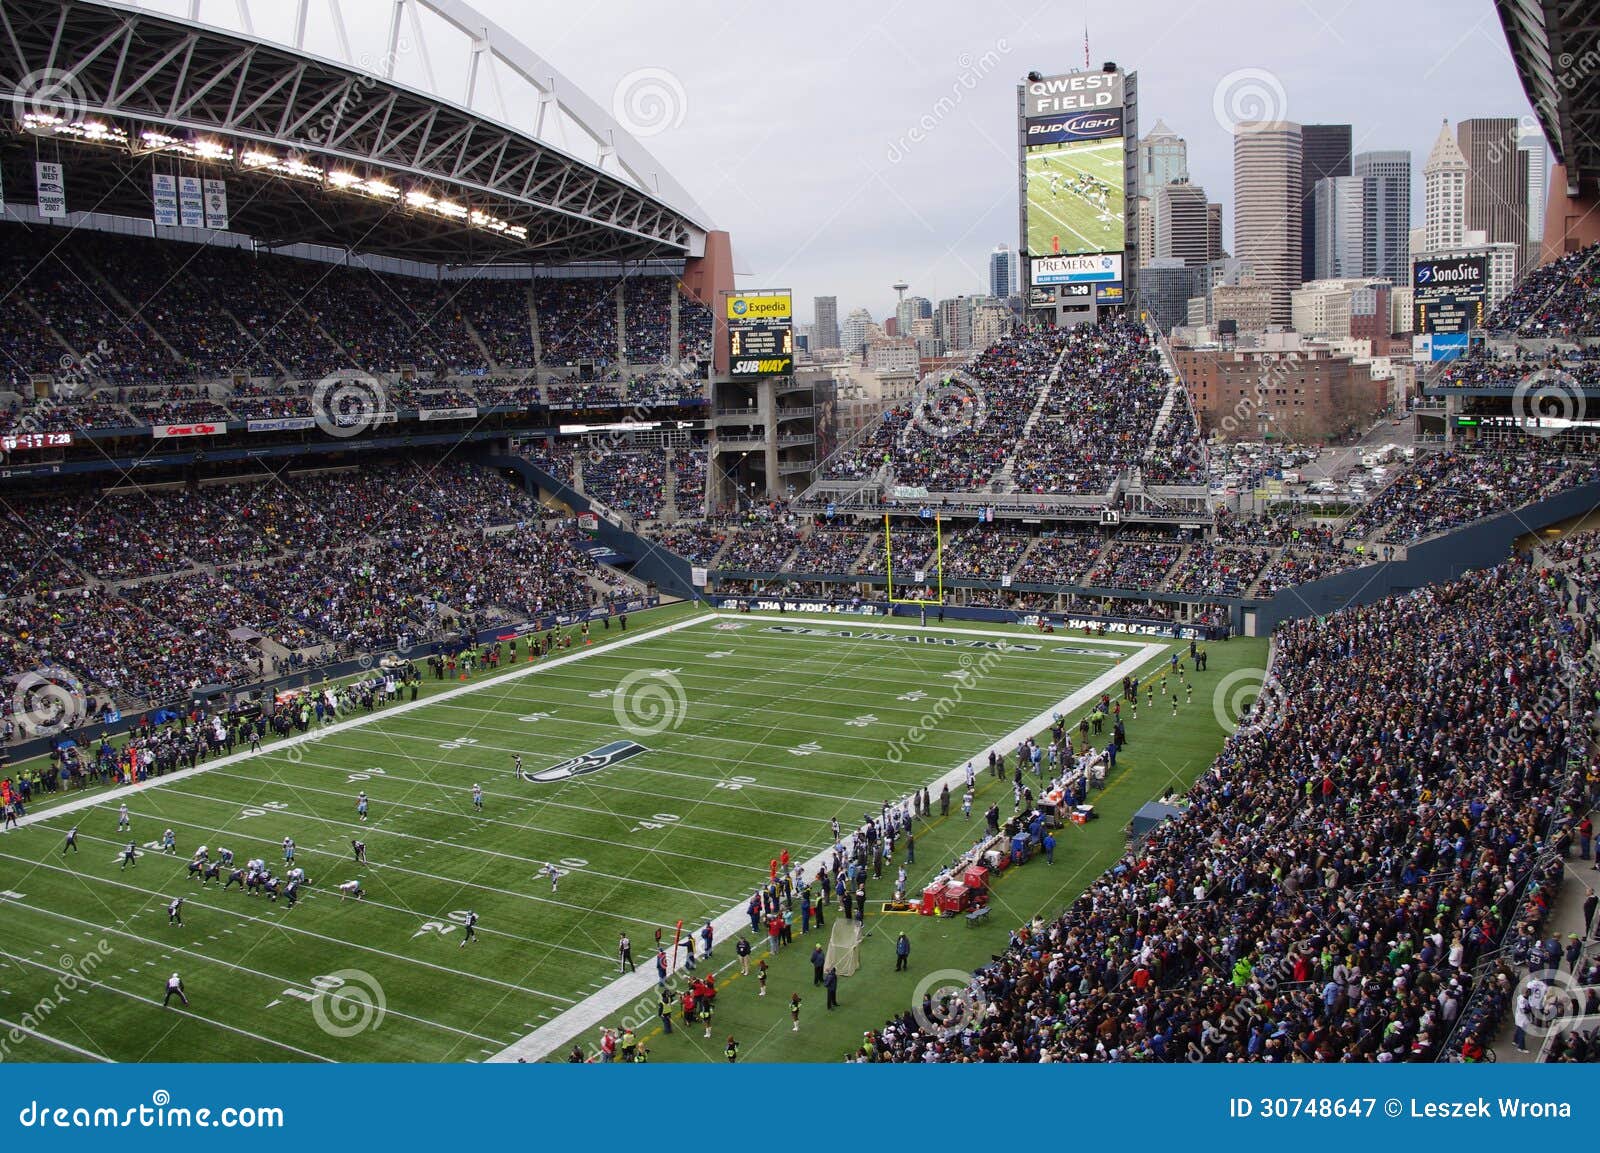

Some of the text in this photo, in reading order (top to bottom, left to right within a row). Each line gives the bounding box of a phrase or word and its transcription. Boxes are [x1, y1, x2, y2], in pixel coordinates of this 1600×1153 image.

[1030, 74, 1118, 96] QWEST
[1037, 92, 1112, 112] FIELD
[1028, 118, 1120, 134] BUD LIGHT
[1038, 260, 1095, 272] PREMERA
[1433, 263, 1479, 282] SonoSite
[750, 302, 785, 313] Expedia
[732, 359, 790, 373] SUBWAY
[5, 440, 16, 448] 19
[48, 434, 71, 444] 7:28
[1110, 623, 1140, 633] YOU
[715, 776, 756, 791] 50
[639, 813, 680, 829] 40
[421, 910, 479, 934] 20
[1530, 954, 1540, 964] 23
[283, 975, 345, 1001] 10
